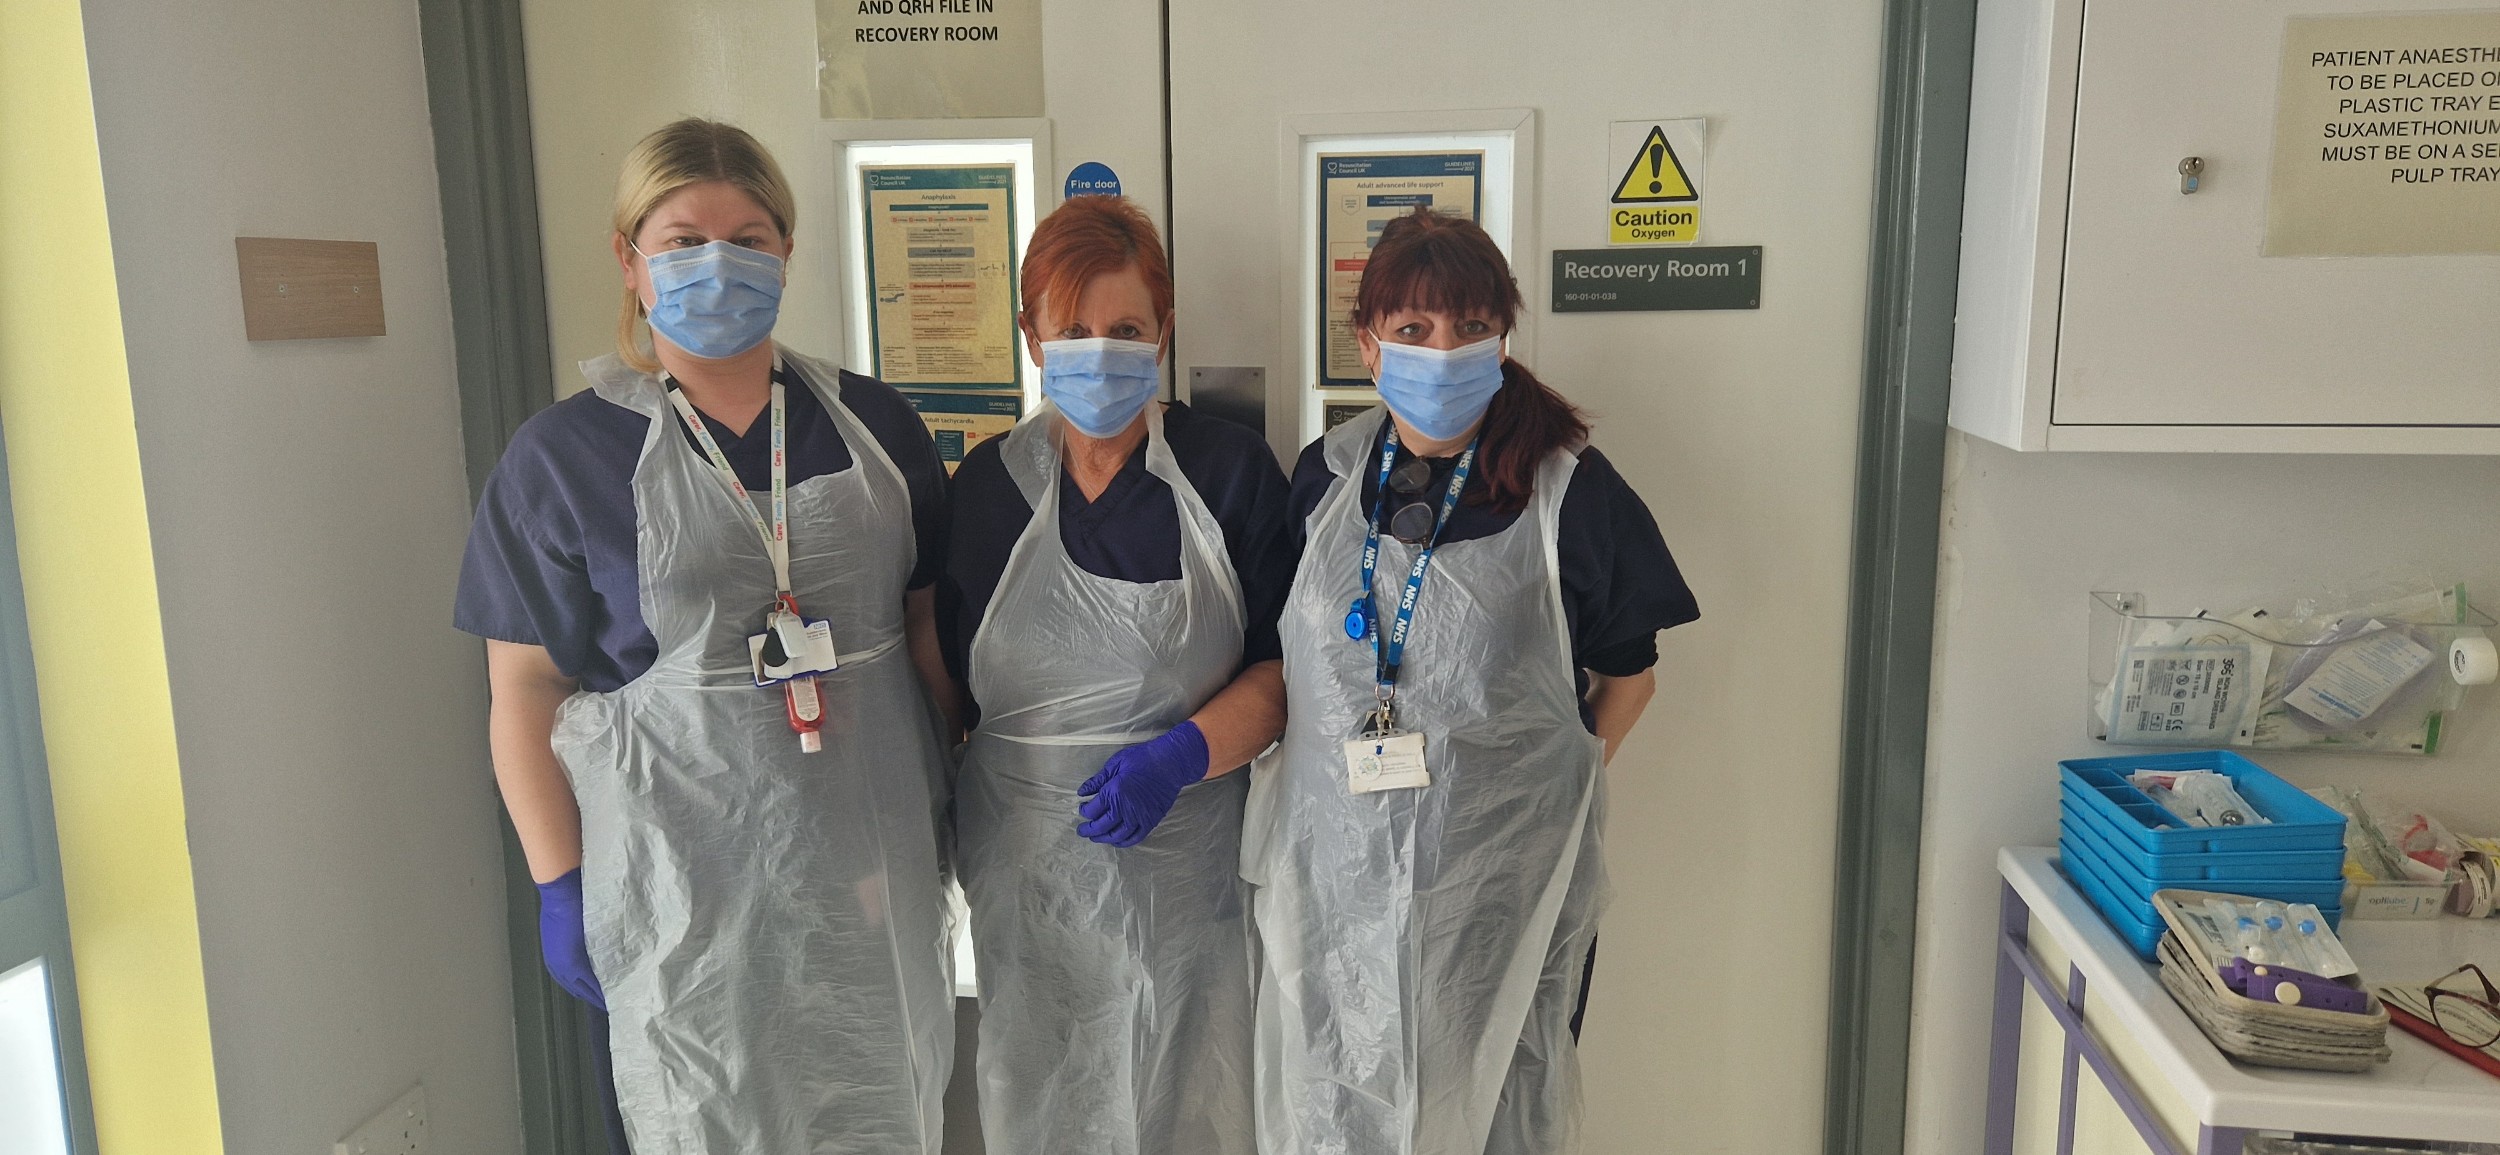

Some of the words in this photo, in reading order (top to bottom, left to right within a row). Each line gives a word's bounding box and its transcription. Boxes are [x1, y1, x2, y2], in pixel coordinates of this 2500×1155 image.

[857, 0, 893, 15] AND
[898, 0, 934, 16] QRH
[940, 0, 970, 13] FILE
[976, 0, 993, 13] IN
[855, 28, 939, 42] RECOVERY
[944, 26, 998, 41] ROOM
[2312, 50, 2395, 67] PATIENT
[2399, 47, 2500, 64] ANAESTH
[2327, 75, 2354, 90] TO
[2360, 74, 2386, 89] BE
[2393, 72, 2475, 88] PLACED
[2481, 71, 2500, 86] O
[2339, 97, 2424, 114] PLASTIC
[2430, 96, 2483, 111] TRAY
[2323, 119, 2500, 138] SUXAMETHONIUM
[2321, 146, 2379, 161] MUST
[2385, 145, 2412, 160] BE
[2418, 144, 2448, 159] ON
[2452, 143, 2466, 158] A
[2471, 143, 2500, 158] SE
[1070, 179, 1091, 189] Fire
[1094, 179, 1117, 189] door
[1419, 181, 1444, 189] support
[2391, 168, 2444, 183] PULP
[2450, 167, 2500, 182] TRAY
[1615, 210, 1692, 226] Caution
[1631, 228, 1675, 239] Oxygen
[1565, 262, 1659, 282] Recovery
[1667, 260, 1728, 276] Room
[1738, 259, 1747, 275] 1
[712, 451, 729, 471] Friend
[1381, 450, 1393, 472] NHS
[1459, 449, 1473, 469] NHS
[774, 478, 782, 498] Friend
[1449, 475, 1464, 498] NHS
[1441, 501, 1452, 523] NHS
[757, 521, 772, 542] Friend
[1369, 519, 1379, 541] NHS
[1364, 546, 1376, 570] NHS
[1412, 554, 1427, 578] NHS
[1402, 584, 1416, 611] NHS
[1369, 618, 1378, 643] NHS
[1393, 617, 1407, 645] NHS
[2214, 677, 2223, 699] ISLAND
[2223, 677, 2231, 690] NON
[2219, 691, 2228, 713] WOVEN
[2209, 700, 2220, 730] DRESSING
